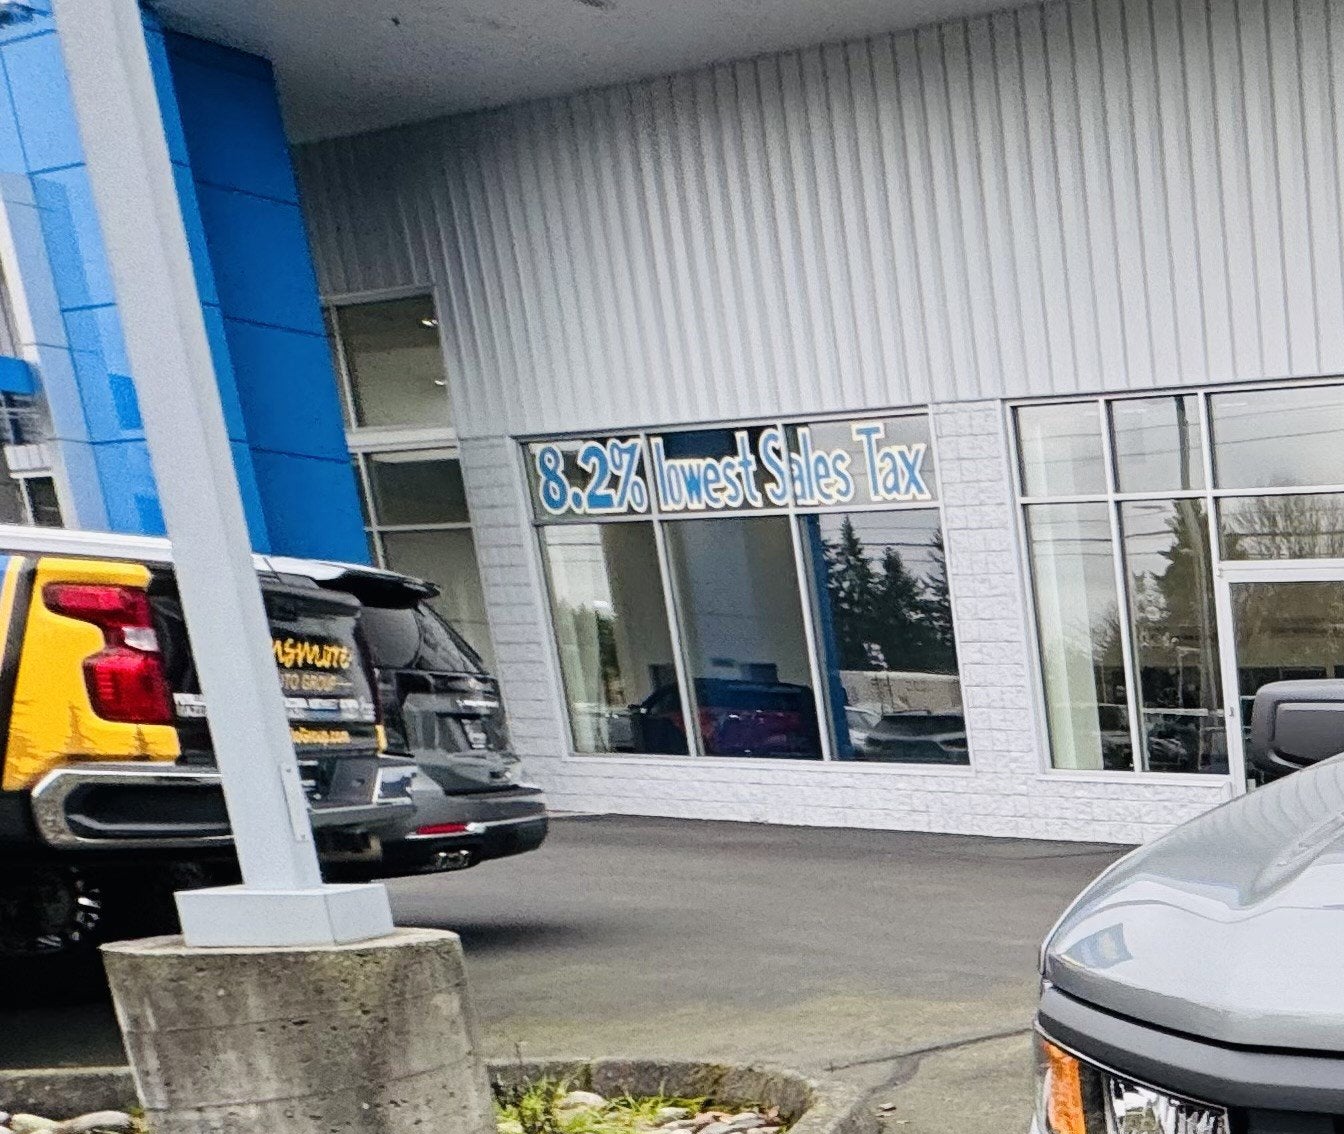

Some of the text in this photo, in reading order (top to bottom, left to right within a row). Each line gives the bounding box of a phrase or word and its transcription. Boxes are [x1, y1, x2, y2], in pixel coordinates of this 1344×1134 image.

[535, 439, 648, 514] 8.2%
[758, 426, 856, 506] Sales
[851, 421, 932, 501] Tax
